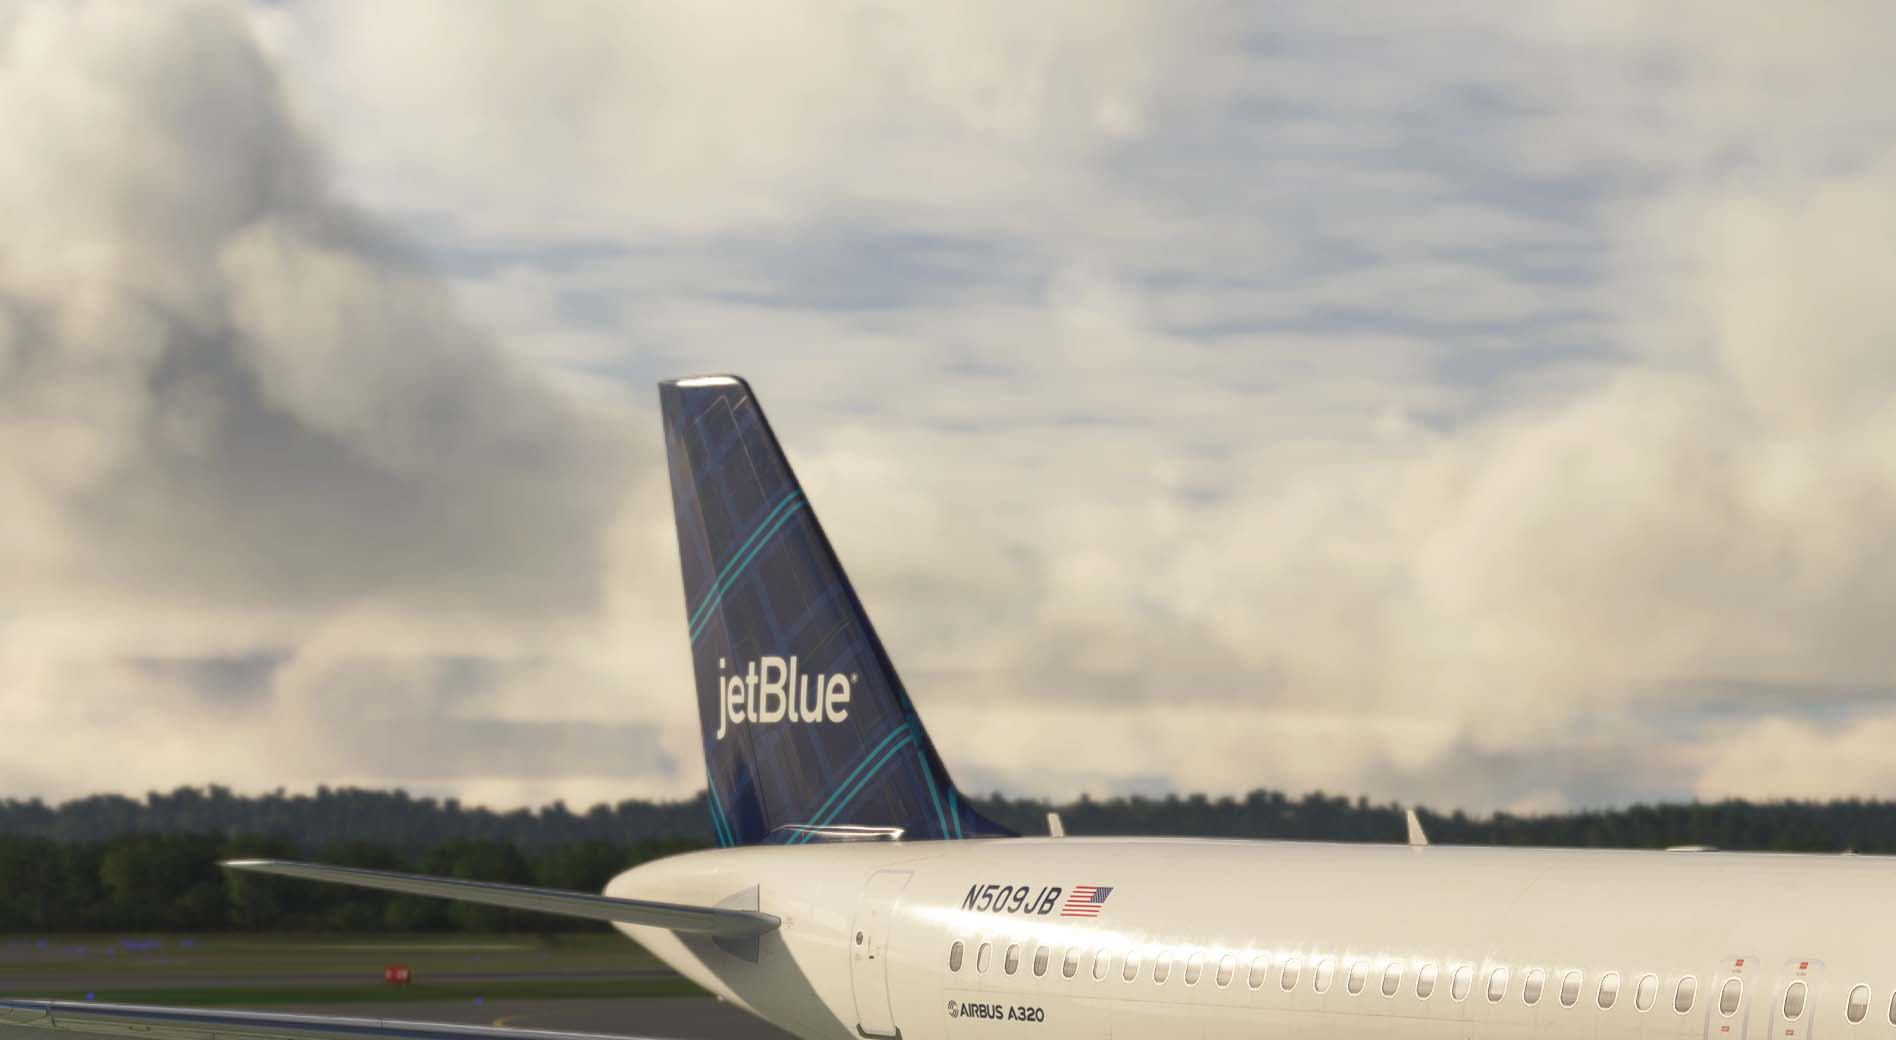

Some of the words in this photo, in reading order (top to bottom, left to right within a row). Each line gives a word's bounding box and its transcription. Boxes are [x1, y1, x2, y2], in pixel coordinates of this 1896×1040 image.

[716, 655, 851, 740] jetBlue
[961, 883, 1062, 915] N509JB
[959, 1003, 1004, 1020] AIRBUS
[1007, 1006, 1045, 1022] A320
